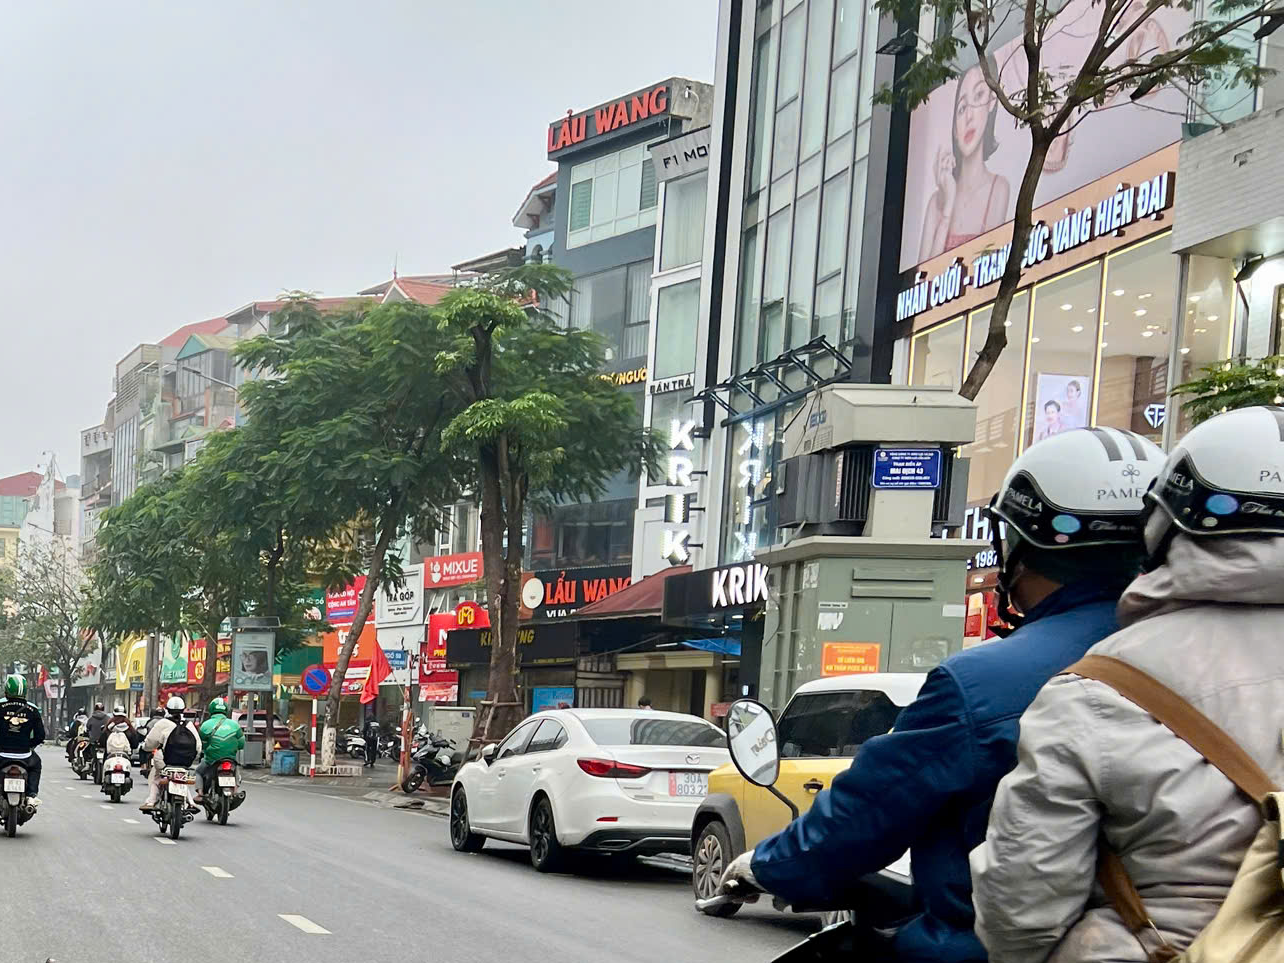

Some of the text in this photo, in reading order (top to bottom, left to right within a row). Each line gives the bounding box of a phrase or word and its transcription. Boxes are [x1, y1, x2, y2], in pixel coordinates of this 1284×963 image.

[547, 85, 666, 152] LẨU WANG
[663, 144, 709, 169] F1 MO
[1052, 207, 1093, 254] VÀNG
[1094, 183, 1135, 236] HIỆN
[1137, 172, 1168, 220] ĐẠI
[650, 374, 692, 394] BÁN TRẢ
[660, 419, 695, 562] KRIK
[443, 559, 478, 575] MIXUE
[545, 570, 576, 604] LẨU
[713, 563, 769, 608] KRIK
[683, 772, 703, 784] 30A
